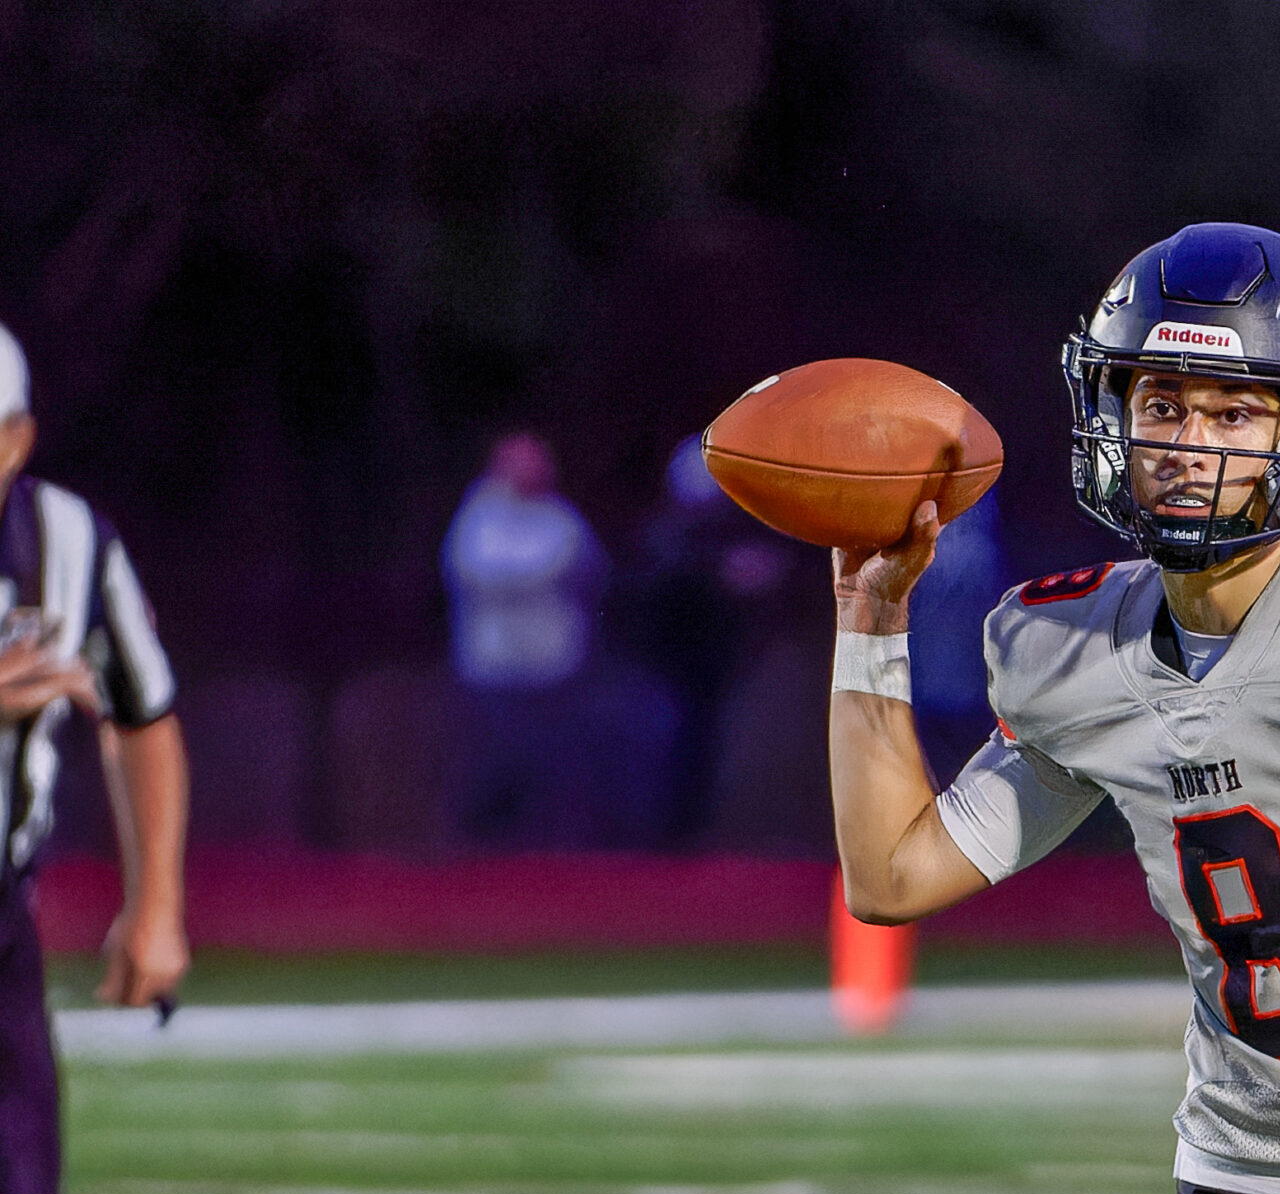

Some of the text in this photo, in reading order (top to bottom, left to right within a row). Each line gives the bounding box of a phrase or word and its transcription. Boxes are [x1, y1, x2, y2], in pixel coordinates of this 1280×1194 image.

[1157, 326, 1231, 348] Riddell
[1161, 528, 1200, 541] Riddell
[1165, 758, 1243, 804] NORTH
